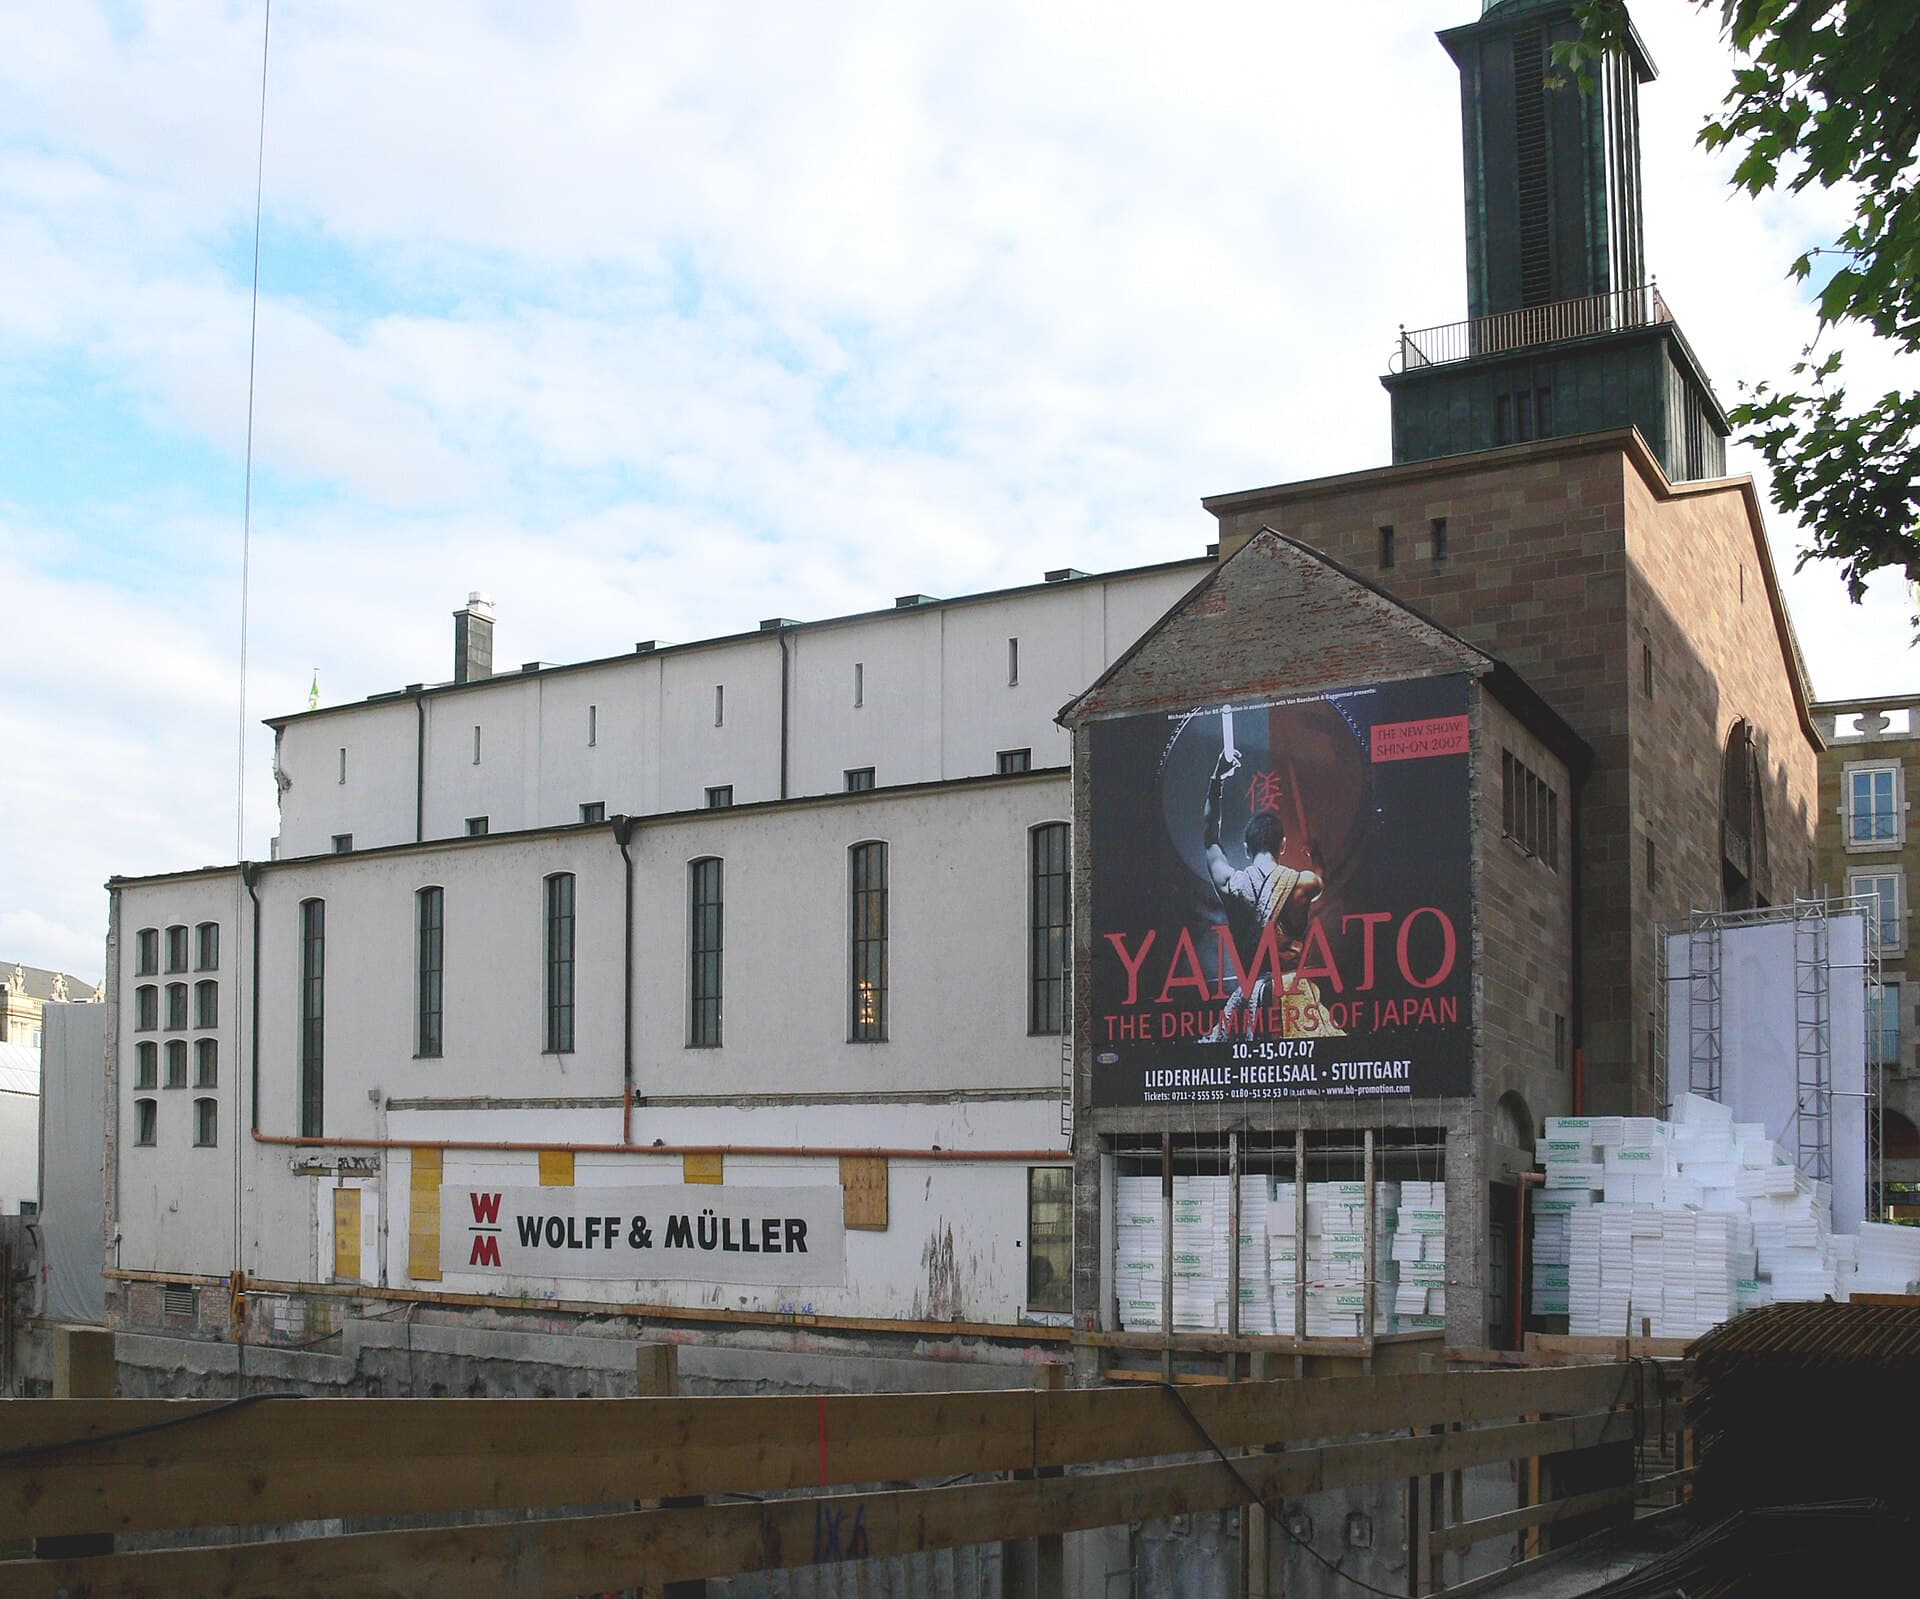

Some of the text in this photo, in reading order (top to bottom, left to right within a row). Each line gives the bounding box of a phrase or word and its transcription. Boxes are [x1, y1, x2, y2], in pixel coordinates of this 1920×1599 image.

[1376, 729, 1397, 740] THE
[1400, 726, 1424, 737] NEW
[1376, 736, 1463, 756] SHIN-ON 2007
[1103, 906, 1457, 1005] YAMATO
[1103, 996, 1458, 1041] THE DRUMMERS OF JAPAN
[1232, 1041, 1315, 1060] 10.-15.07.07
[1145, 1060, 1411, 1088] LIEDERHALLE-HEGELSAAL STUTTGART
[1144, 1091, 1171, 1102] Tickets:
[1197, 1091, 1209, 1100] 555
[1211, 1090, 1224, 1100] 555
[1326, 1083, 1411, 1096] www.bb-promotion.com
[516, 1208, 808, 1253] WOLFF & MÜLLER
